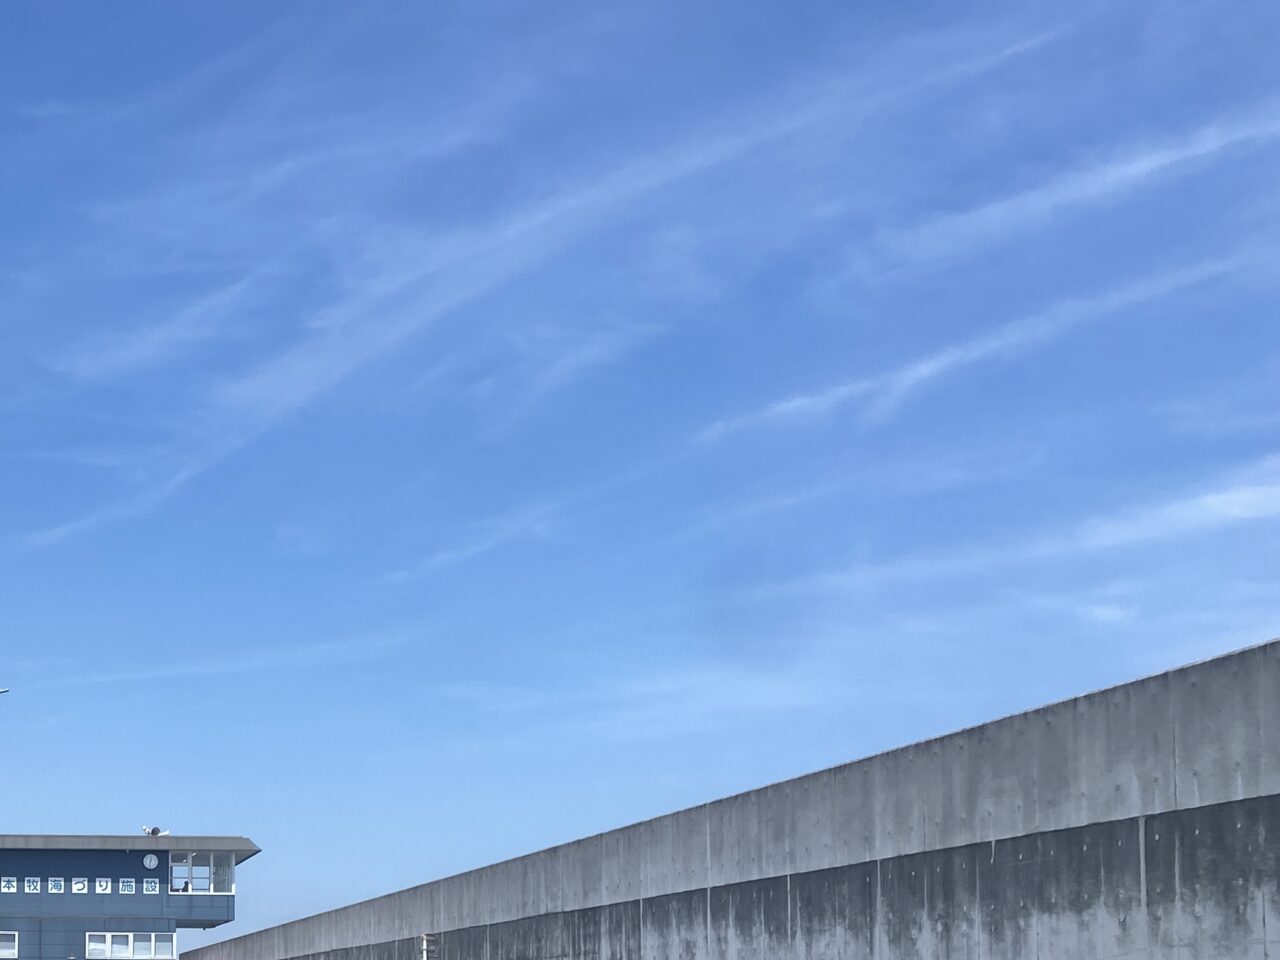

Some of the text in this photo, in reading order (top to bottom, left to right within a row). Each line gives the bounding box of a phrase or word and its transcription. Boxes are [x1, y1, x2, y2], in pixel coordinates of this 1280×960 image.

[3, 878, 158, 893] 本牧海づり施設
